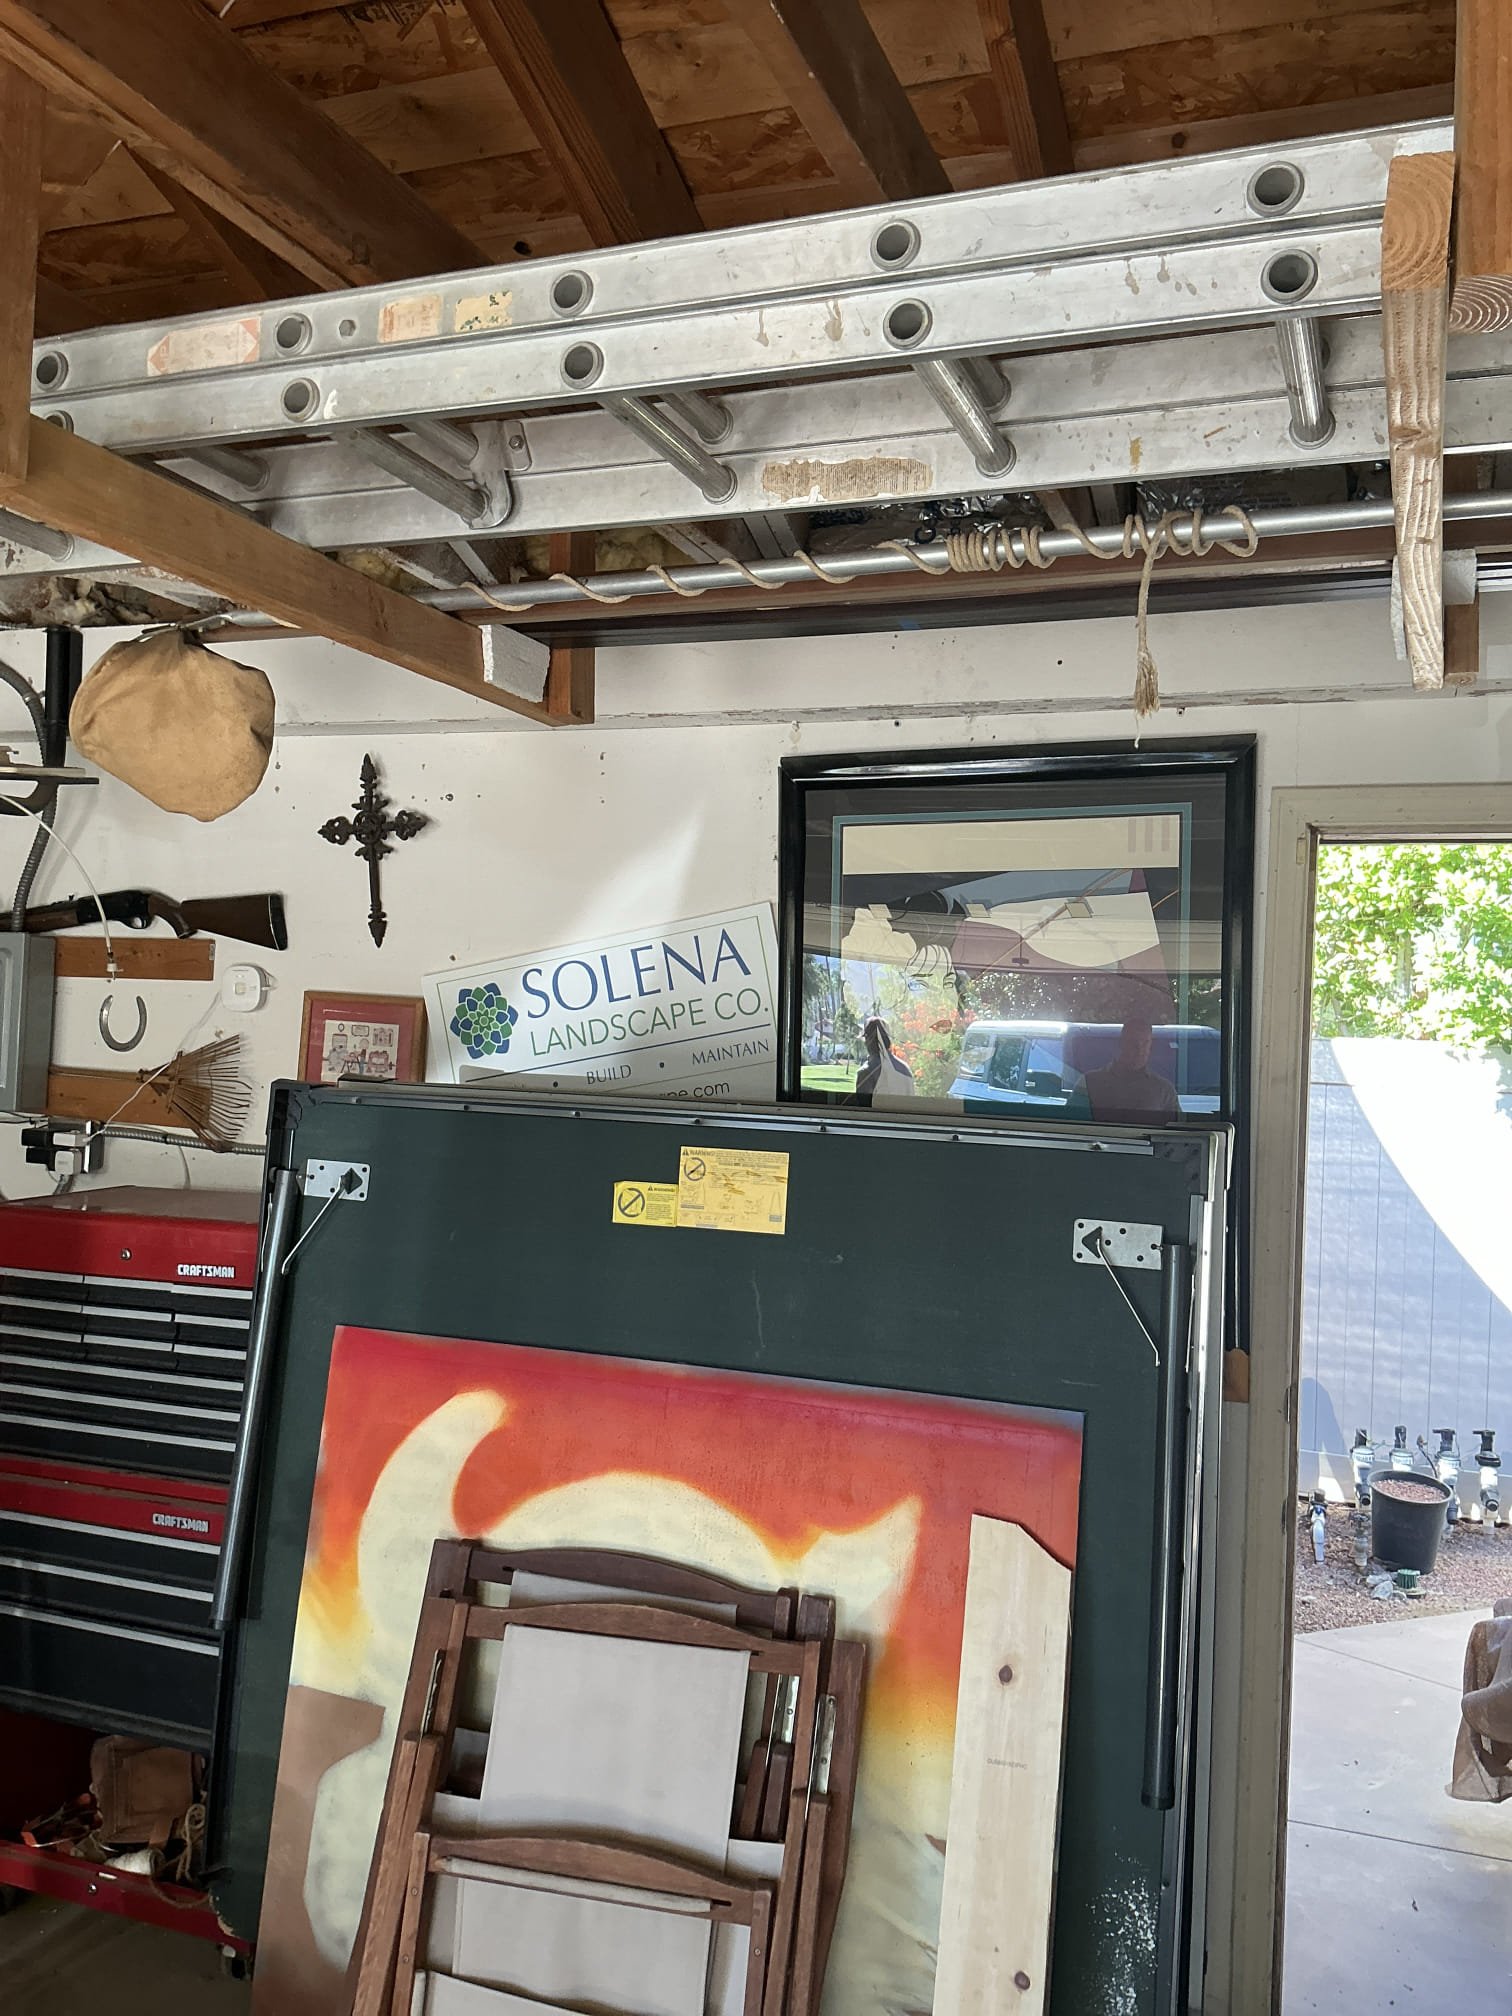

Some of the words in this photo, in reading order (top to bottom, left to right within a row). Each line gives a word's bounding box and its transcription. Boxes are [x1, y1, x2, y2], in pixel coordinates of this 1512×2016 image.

[522, 928, 751, 1018] SOLENA
[531, 998, 706, 1056] LANDSCAPE
[714, 988, 769, 1020] CO.
[586, 1064, 632, 1085] BUILD
[691, 1039, 770, 1066] MAINTAIN
[177, 1264, 235, 1280] CRAFTSMAN
[152, 1513, 209, 1533] CRAFTSMAN
